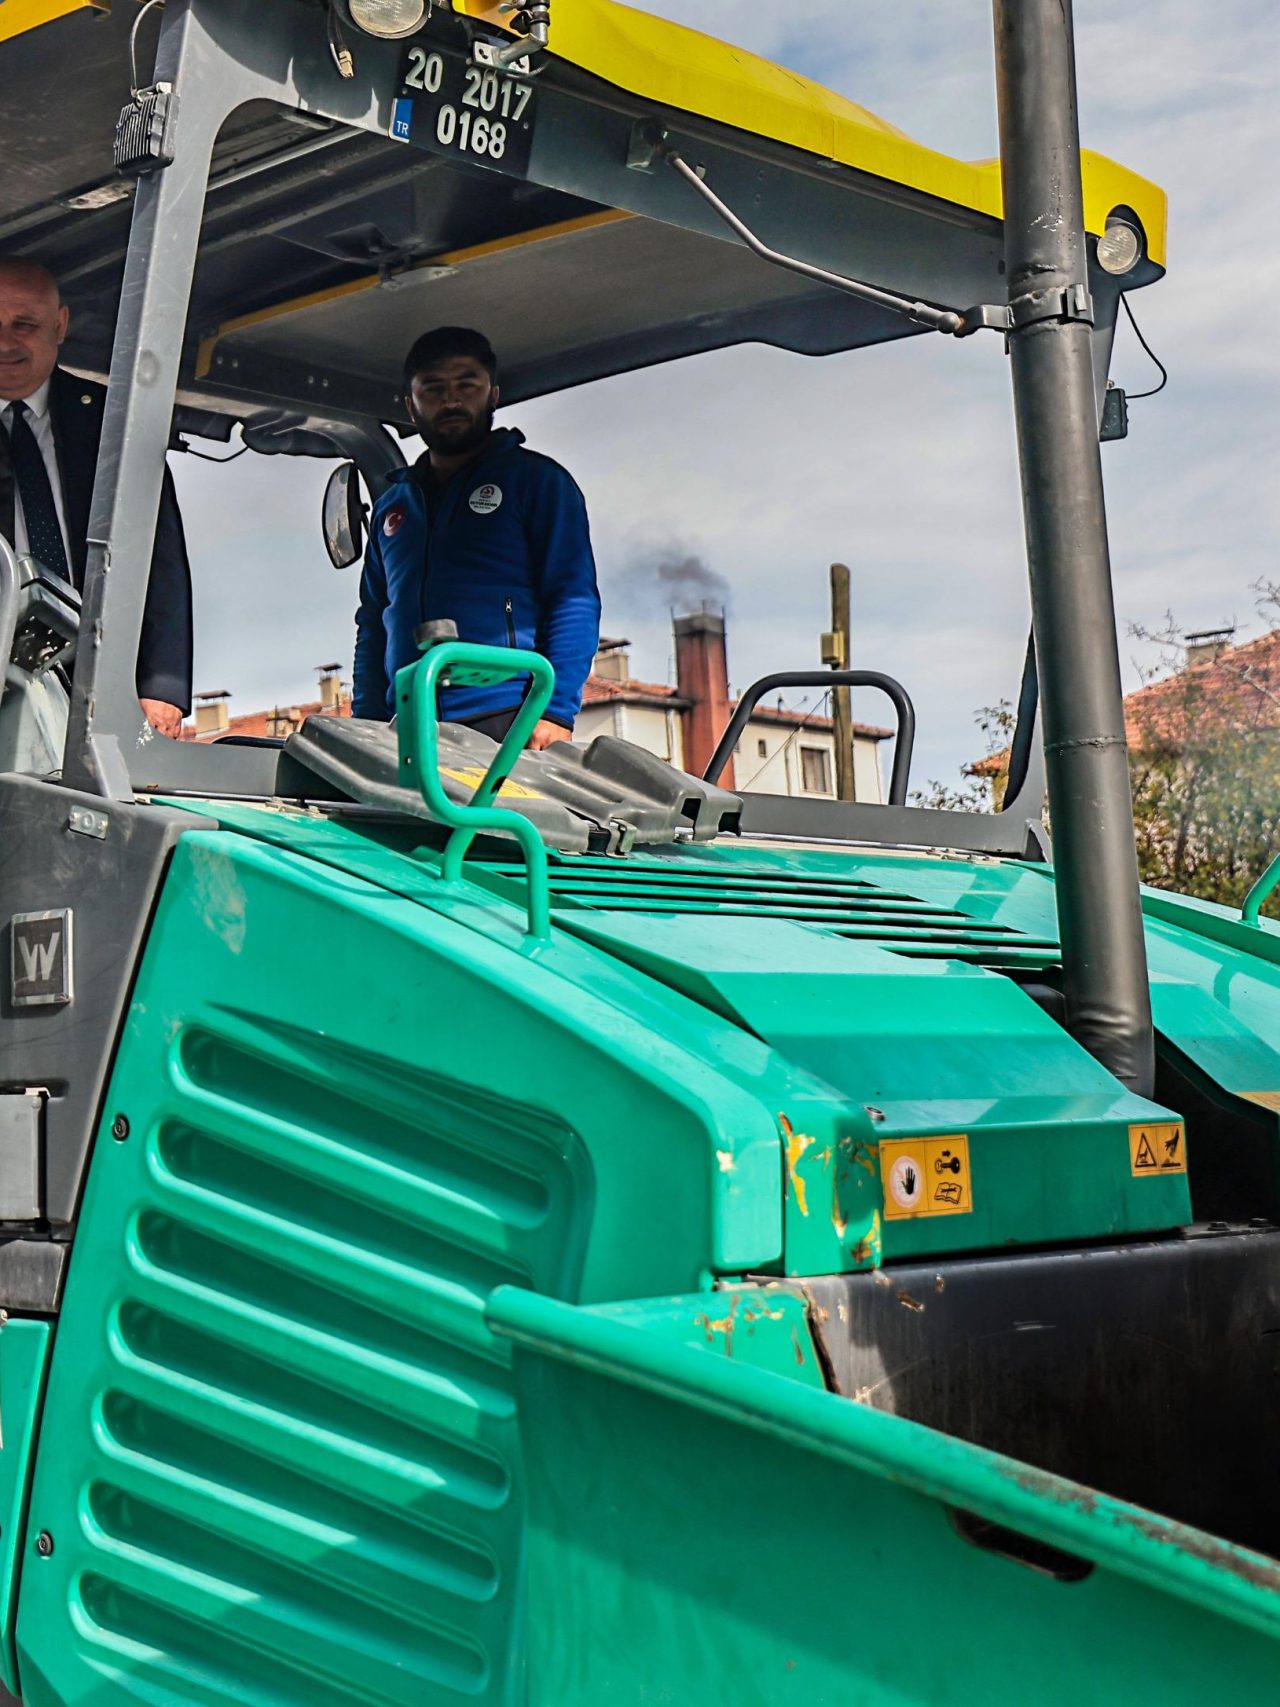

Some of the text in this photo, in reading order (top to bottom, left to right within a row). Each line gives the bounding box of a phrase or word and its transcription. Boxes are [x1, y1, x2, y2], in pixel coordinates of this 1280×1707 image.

[405, 47, 532, 121] 20 2017
[396, 120, 409, 136] TR
[437, 104, 506, 159] 0168
